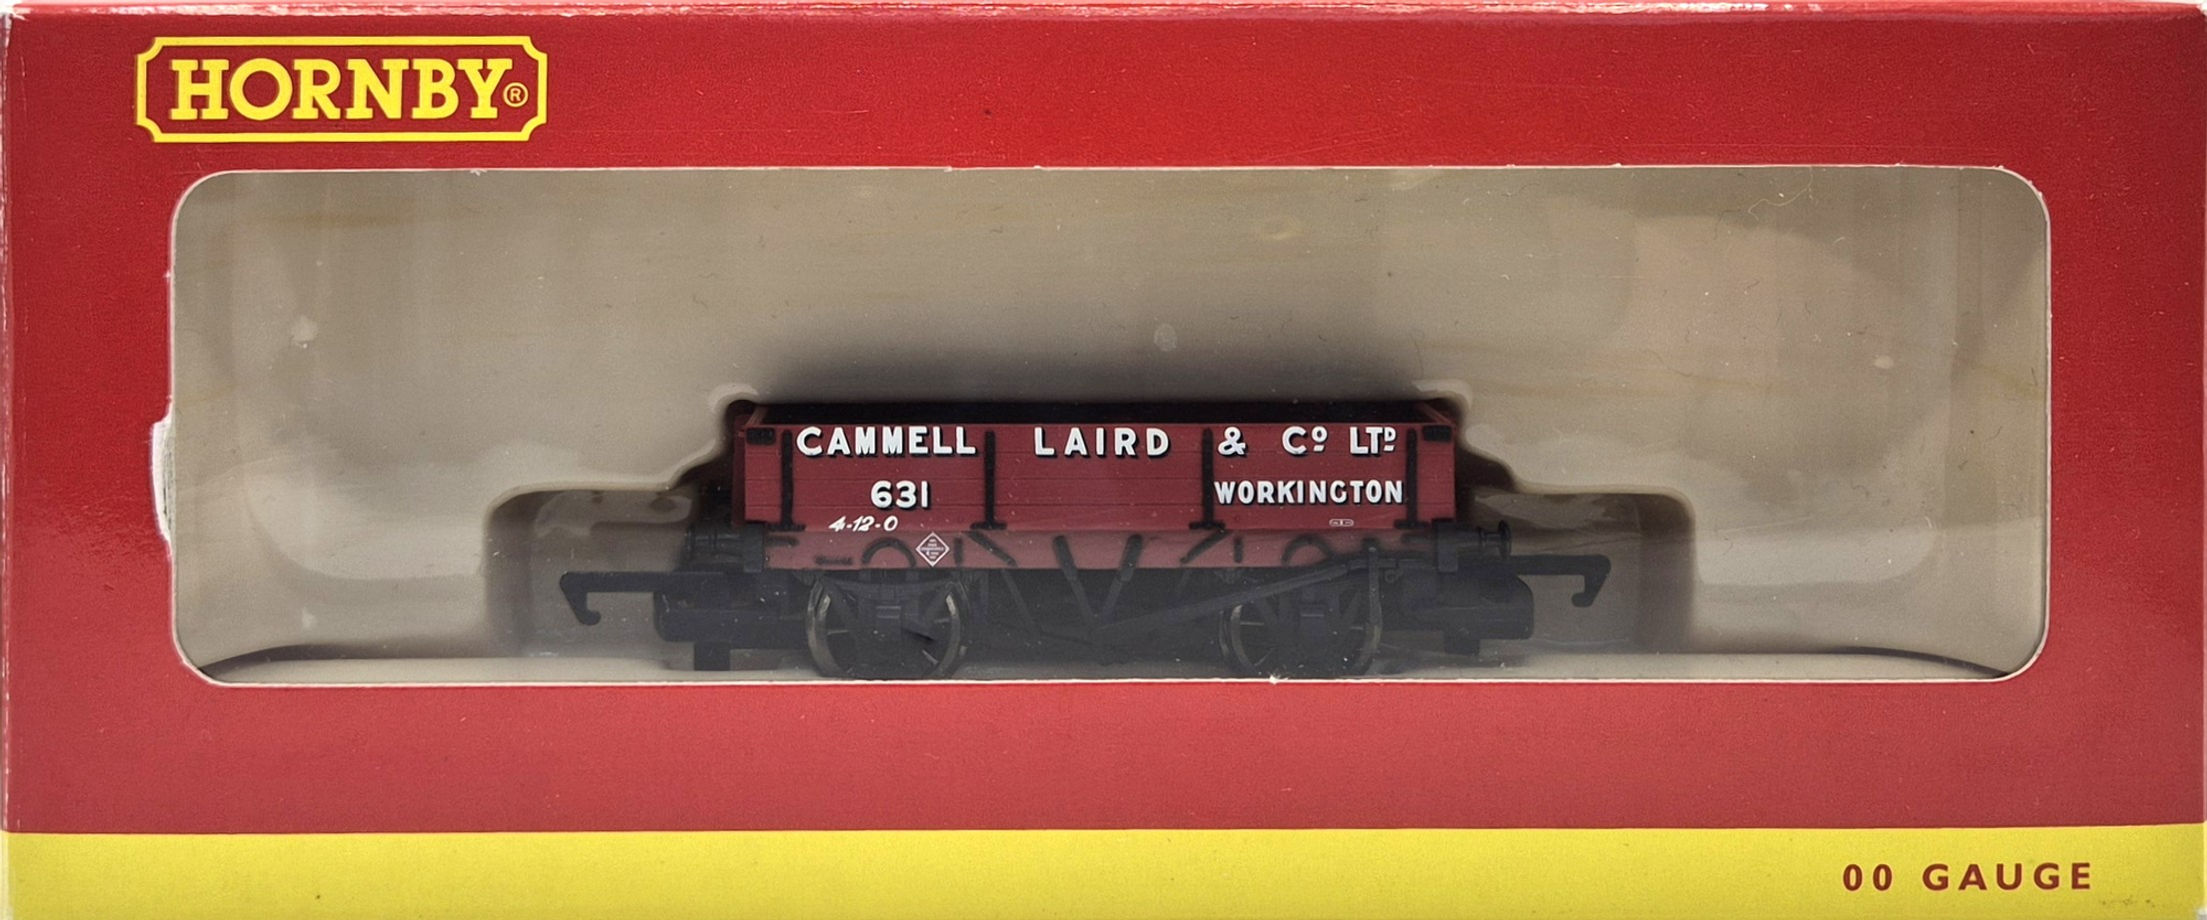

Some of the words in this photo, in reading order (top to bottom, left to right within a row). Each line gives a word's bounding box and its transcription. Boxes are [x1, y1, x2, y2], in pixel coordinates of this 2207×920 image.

[796, 426, 977, 457] CAMMELL
[1034, 427, 1170, 457] LAIRD
[1217, 426, 1247, 456] &
[870, 480, 930, 509] 631
[1214, 479, 1404, 504] WORKINGTON
[828, 515, 899, 532] 4-12-0
[1922, 861, 2092, 891] GAUGE
